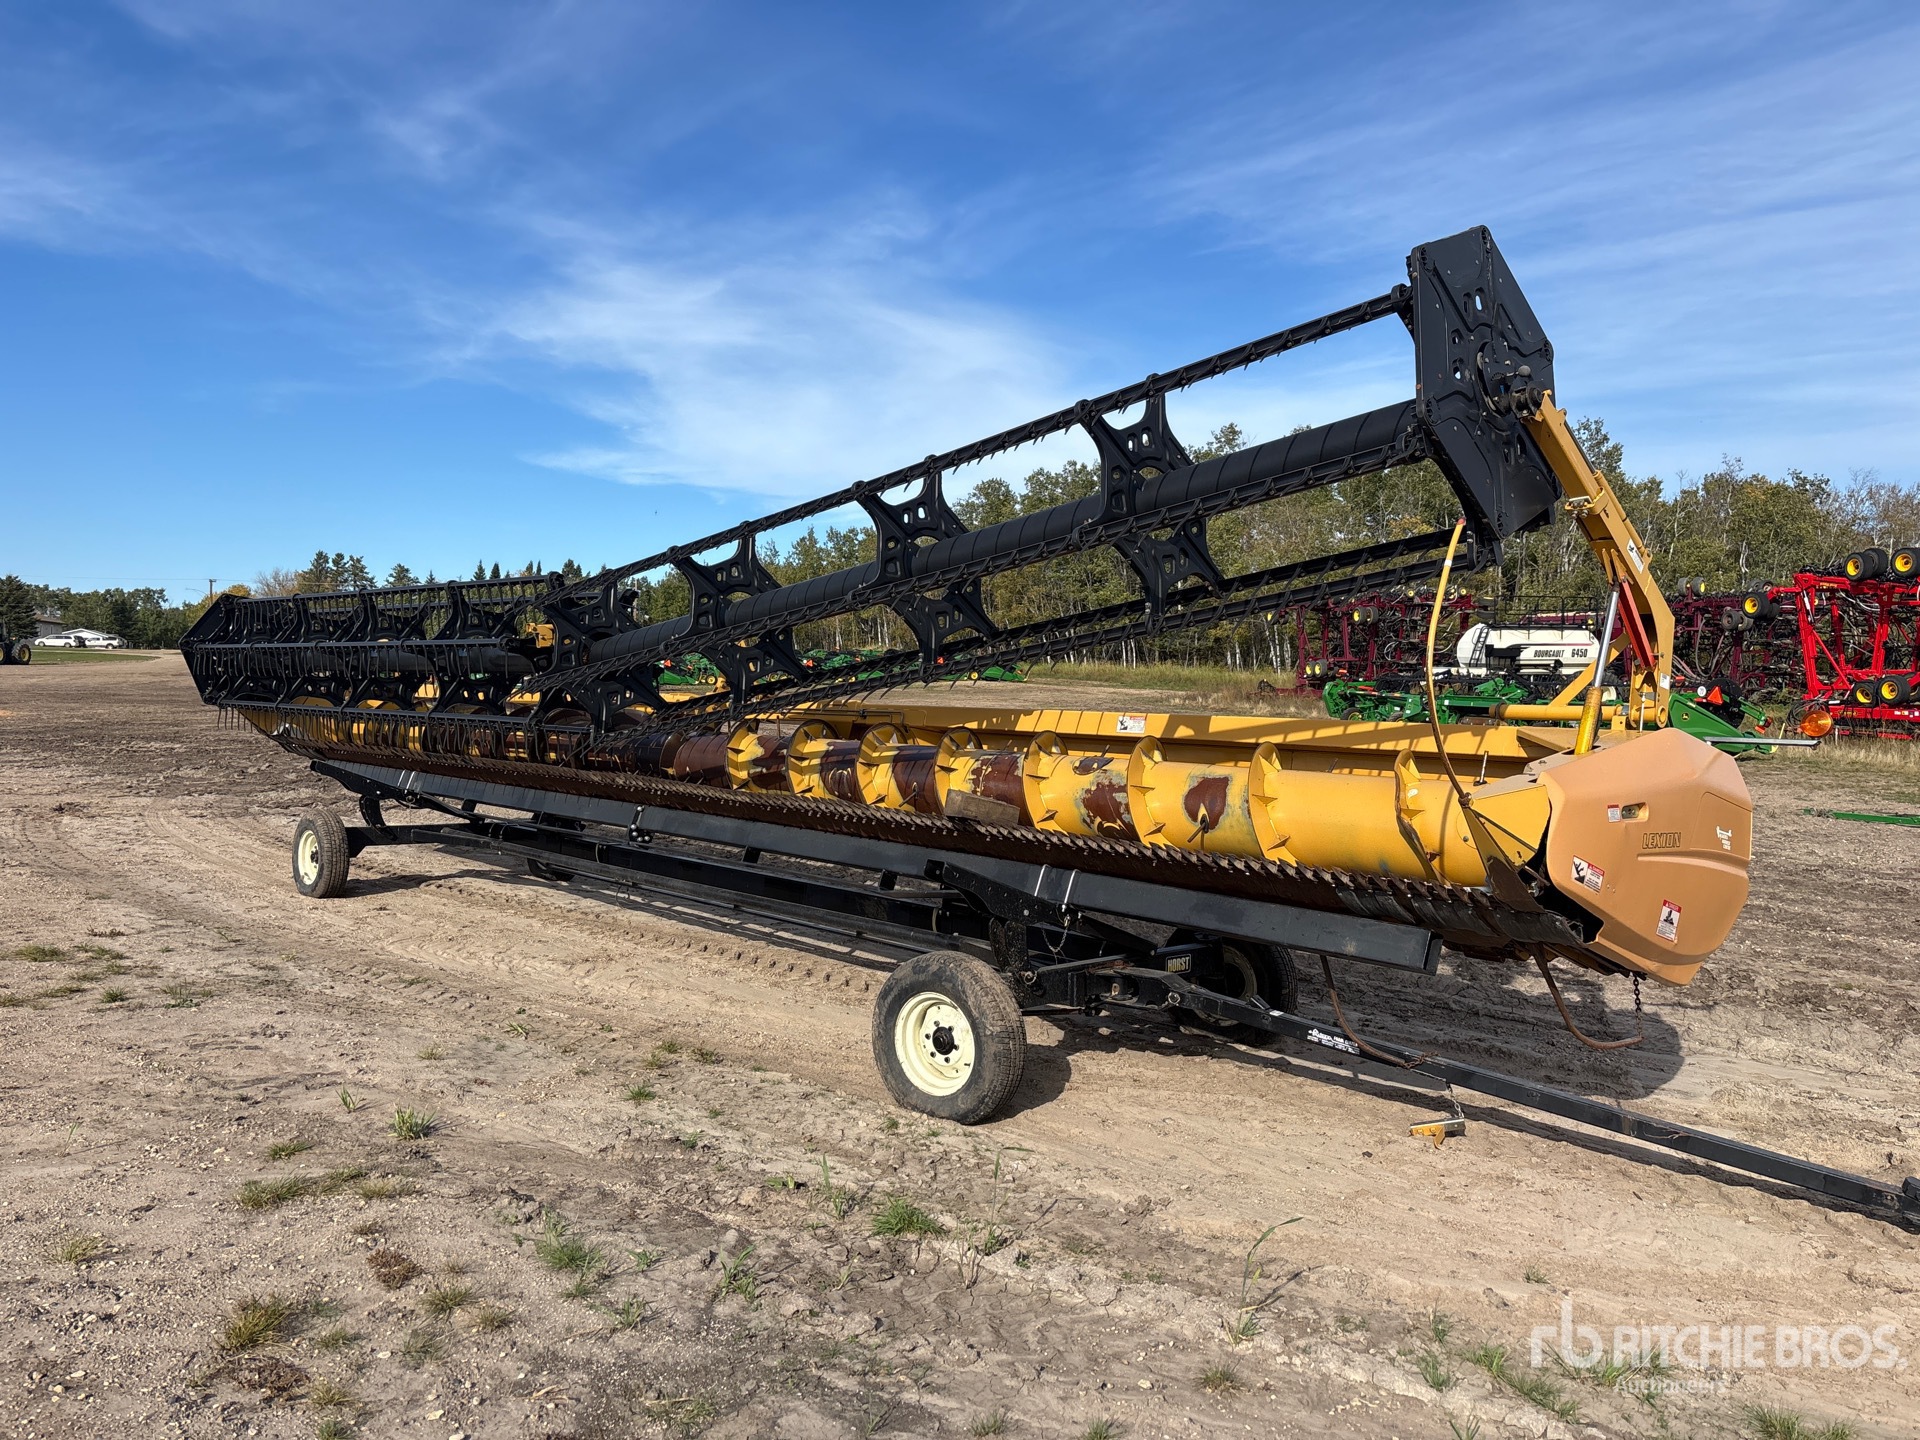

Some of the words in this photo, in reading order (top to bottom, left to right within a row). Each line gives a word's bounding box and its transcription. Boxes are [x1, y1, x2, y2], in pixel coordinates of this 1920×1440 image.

[1533, 649, 1565, 658] BOURGAULT
[1571, 648, 1588, 658] 6450
[1642, 832, 1682, 850] LEXION
[1167, 956, 1190, 973] HORST
